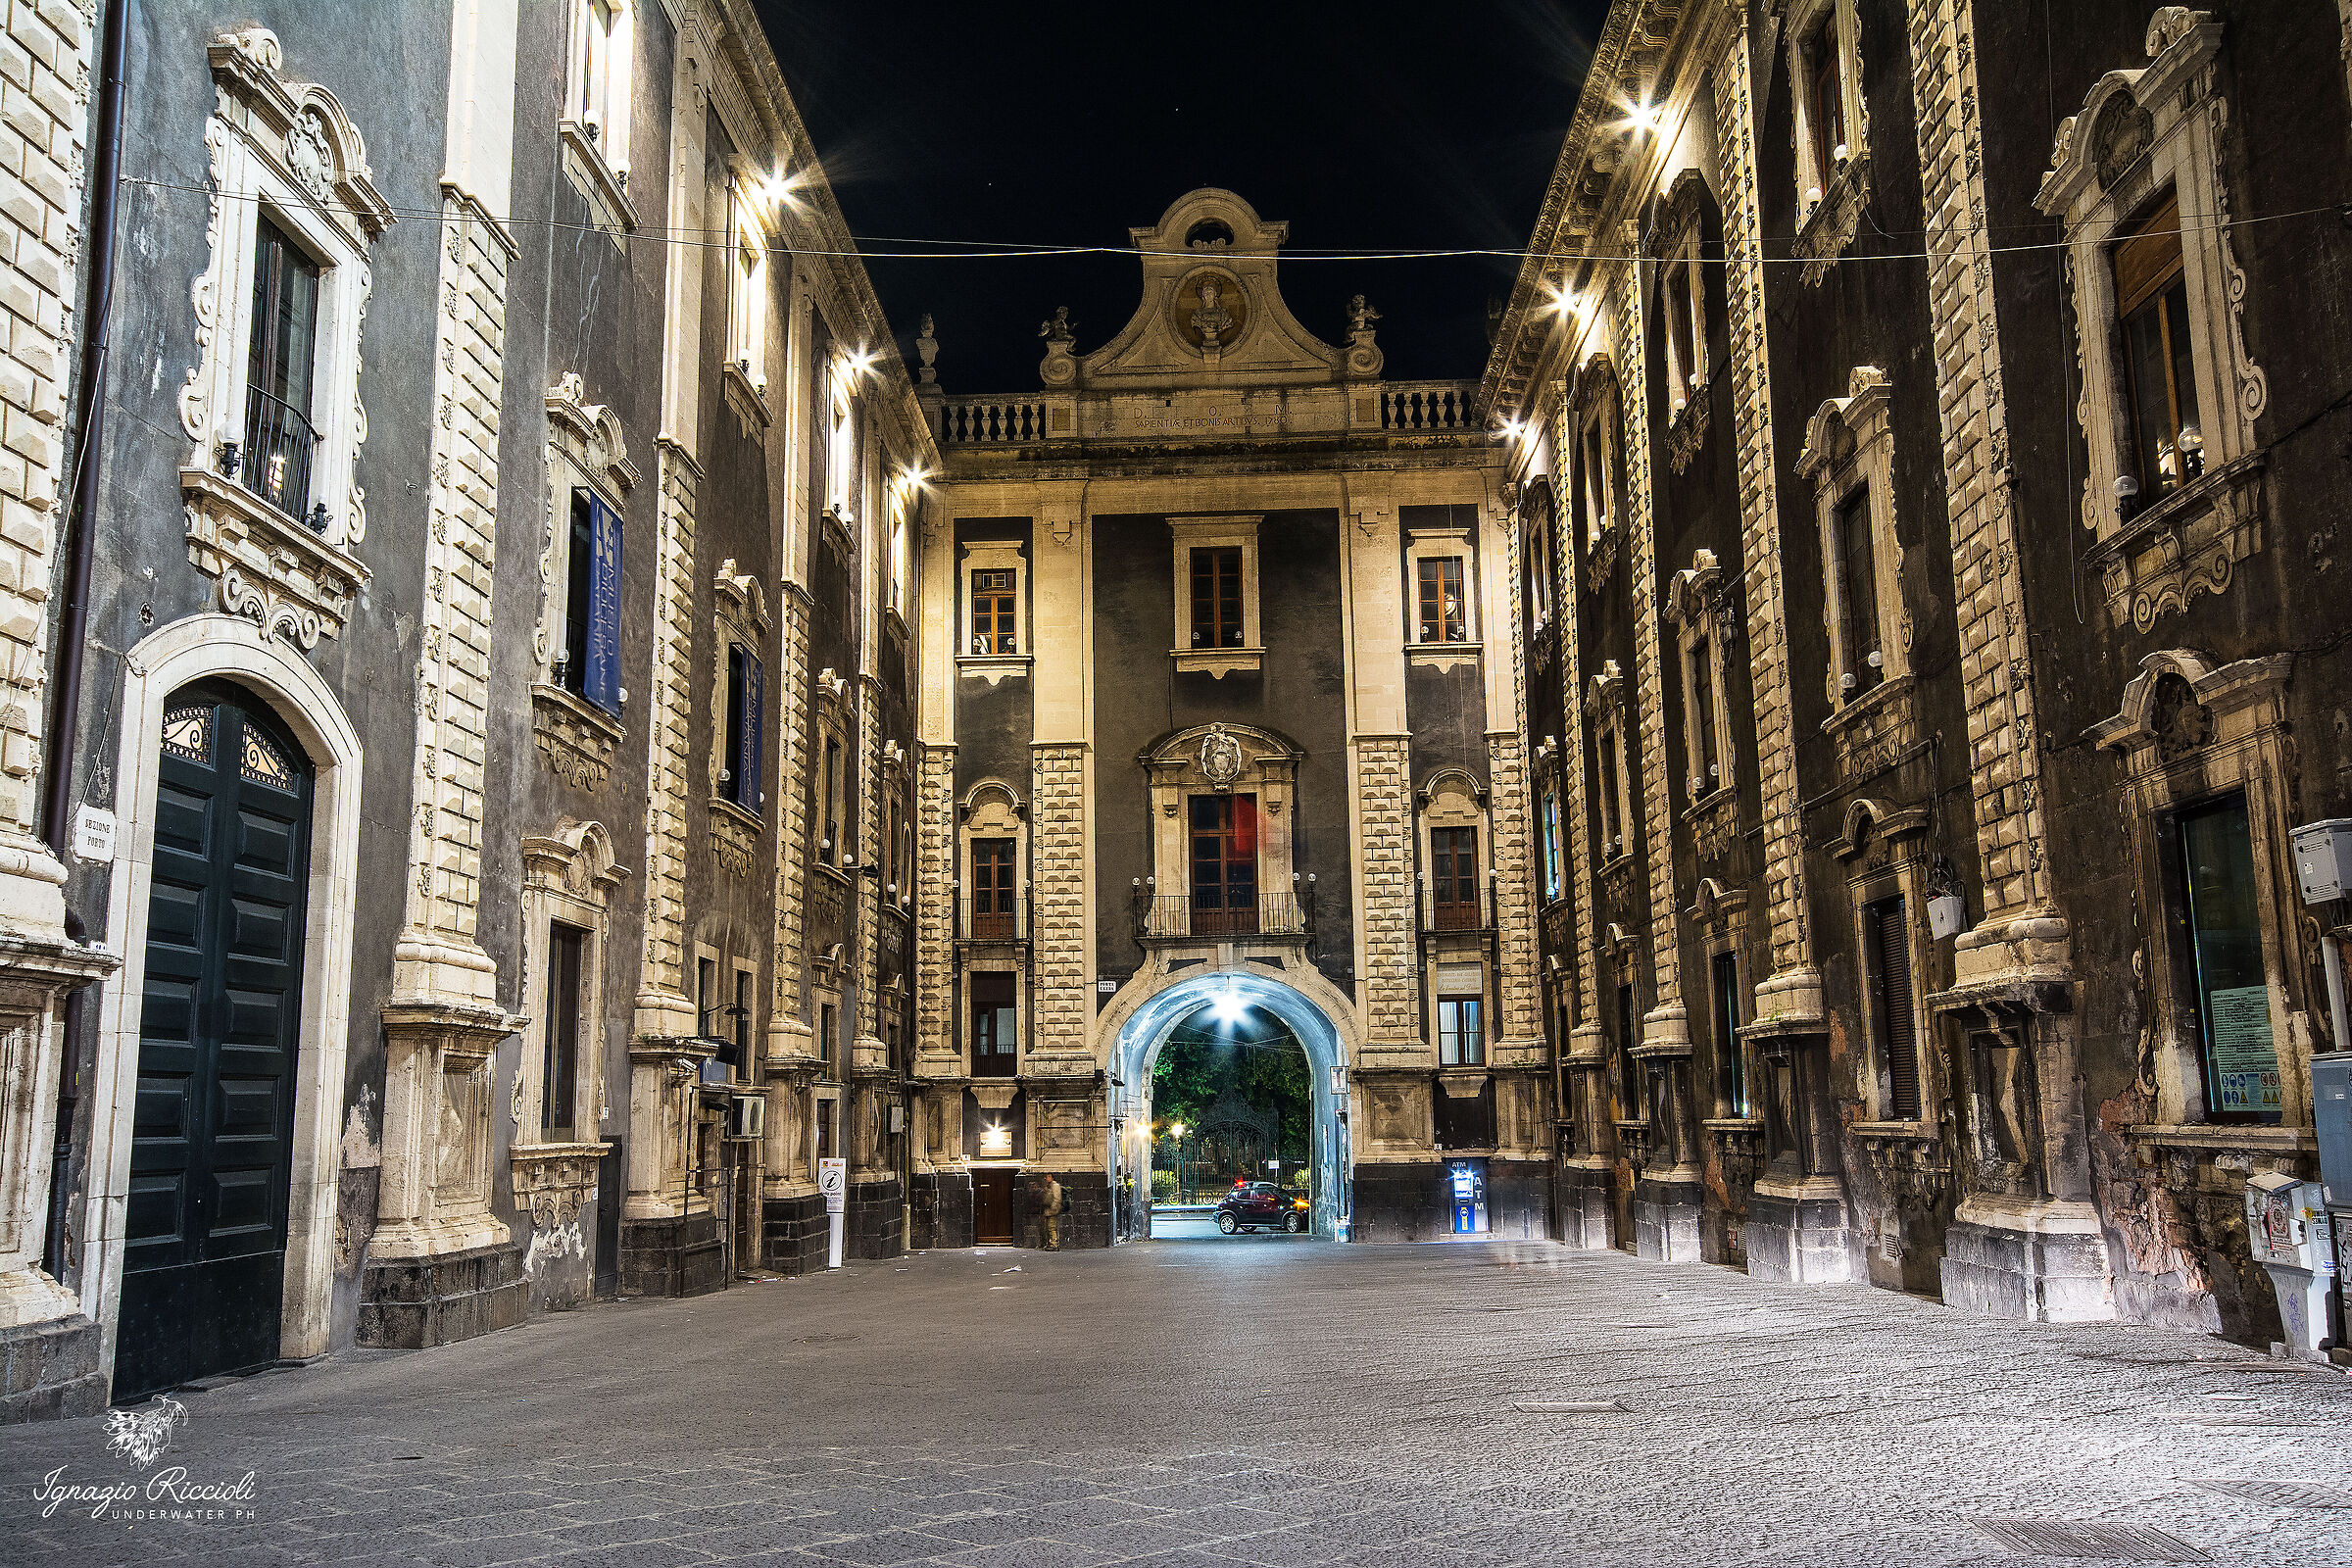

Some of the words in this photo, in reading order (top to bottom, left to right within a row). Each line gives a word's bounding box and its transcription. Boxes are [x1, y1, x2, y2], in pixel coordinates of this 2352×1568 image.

[1195, 417, 1221, 427] BONIS
[85, 818, 111, 834] SEZIONE
[87, 835, 106, 849] PORTO
